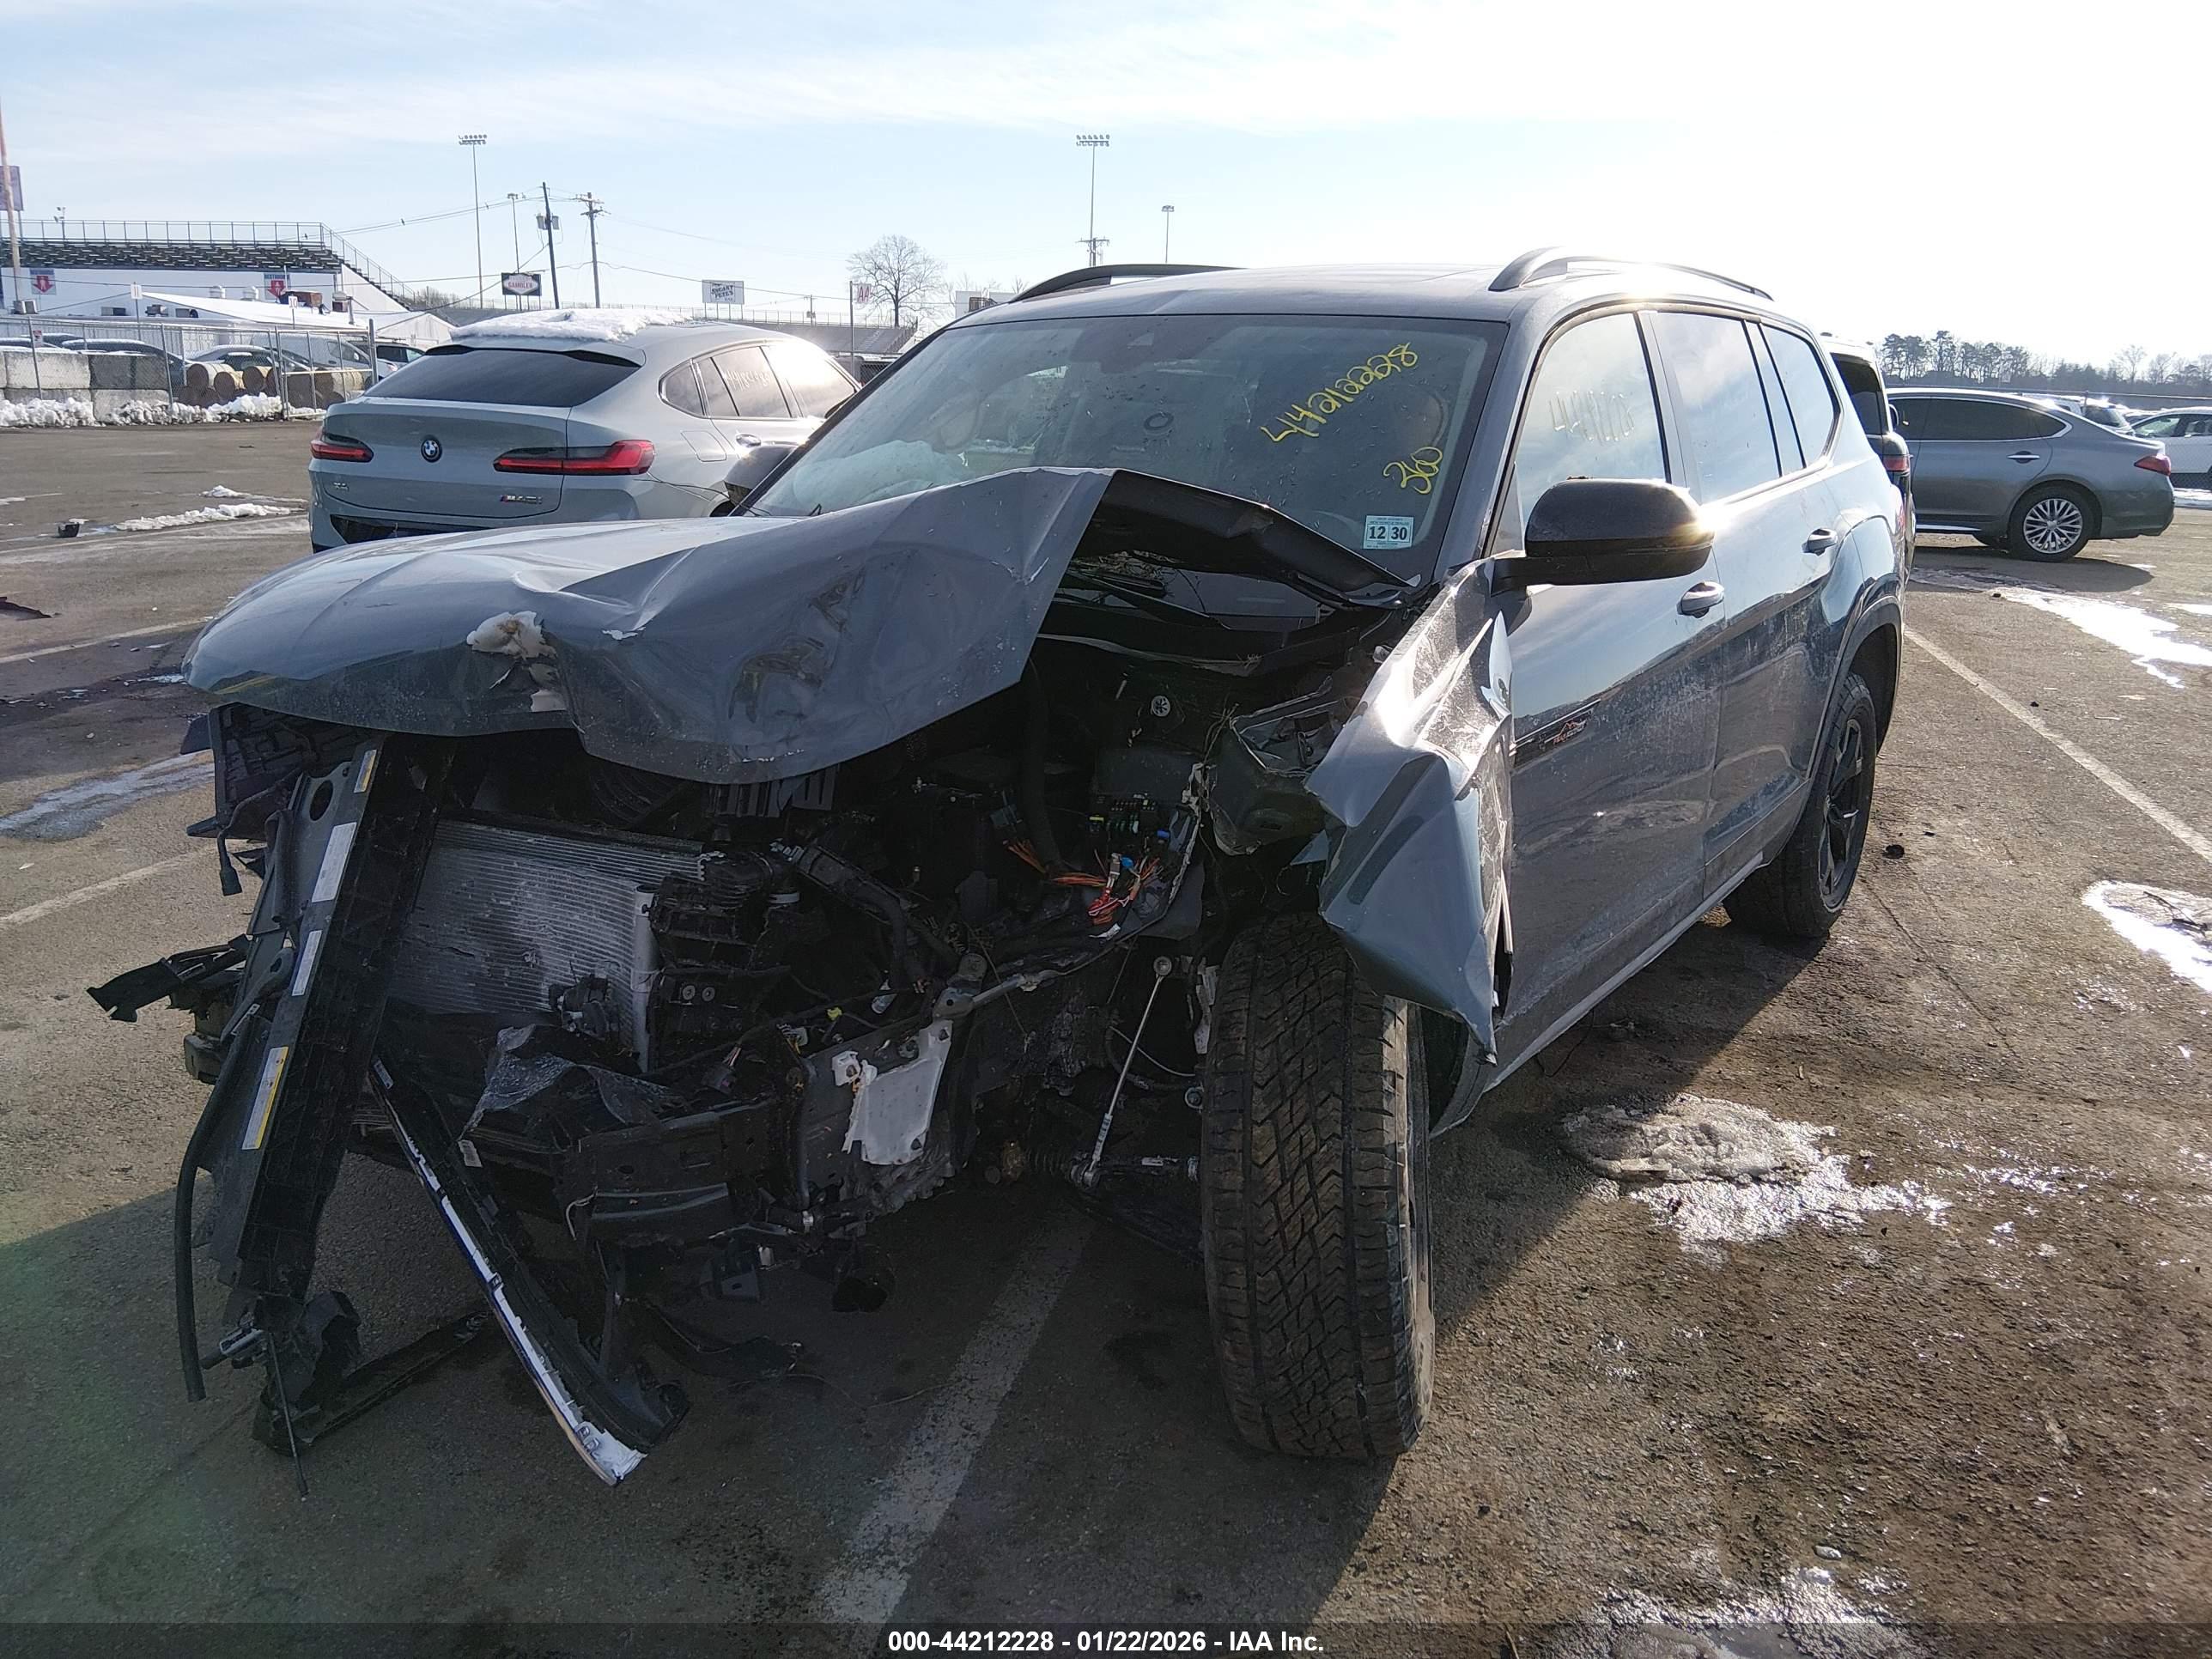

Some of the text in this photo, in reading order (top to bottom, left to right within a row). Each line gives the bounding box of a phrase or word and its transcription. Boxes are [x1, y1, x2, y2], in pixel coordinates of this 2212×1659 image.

[1260, 342, 1418, 441] 44212228
[1369, 526, 1407, 541] 12 30
